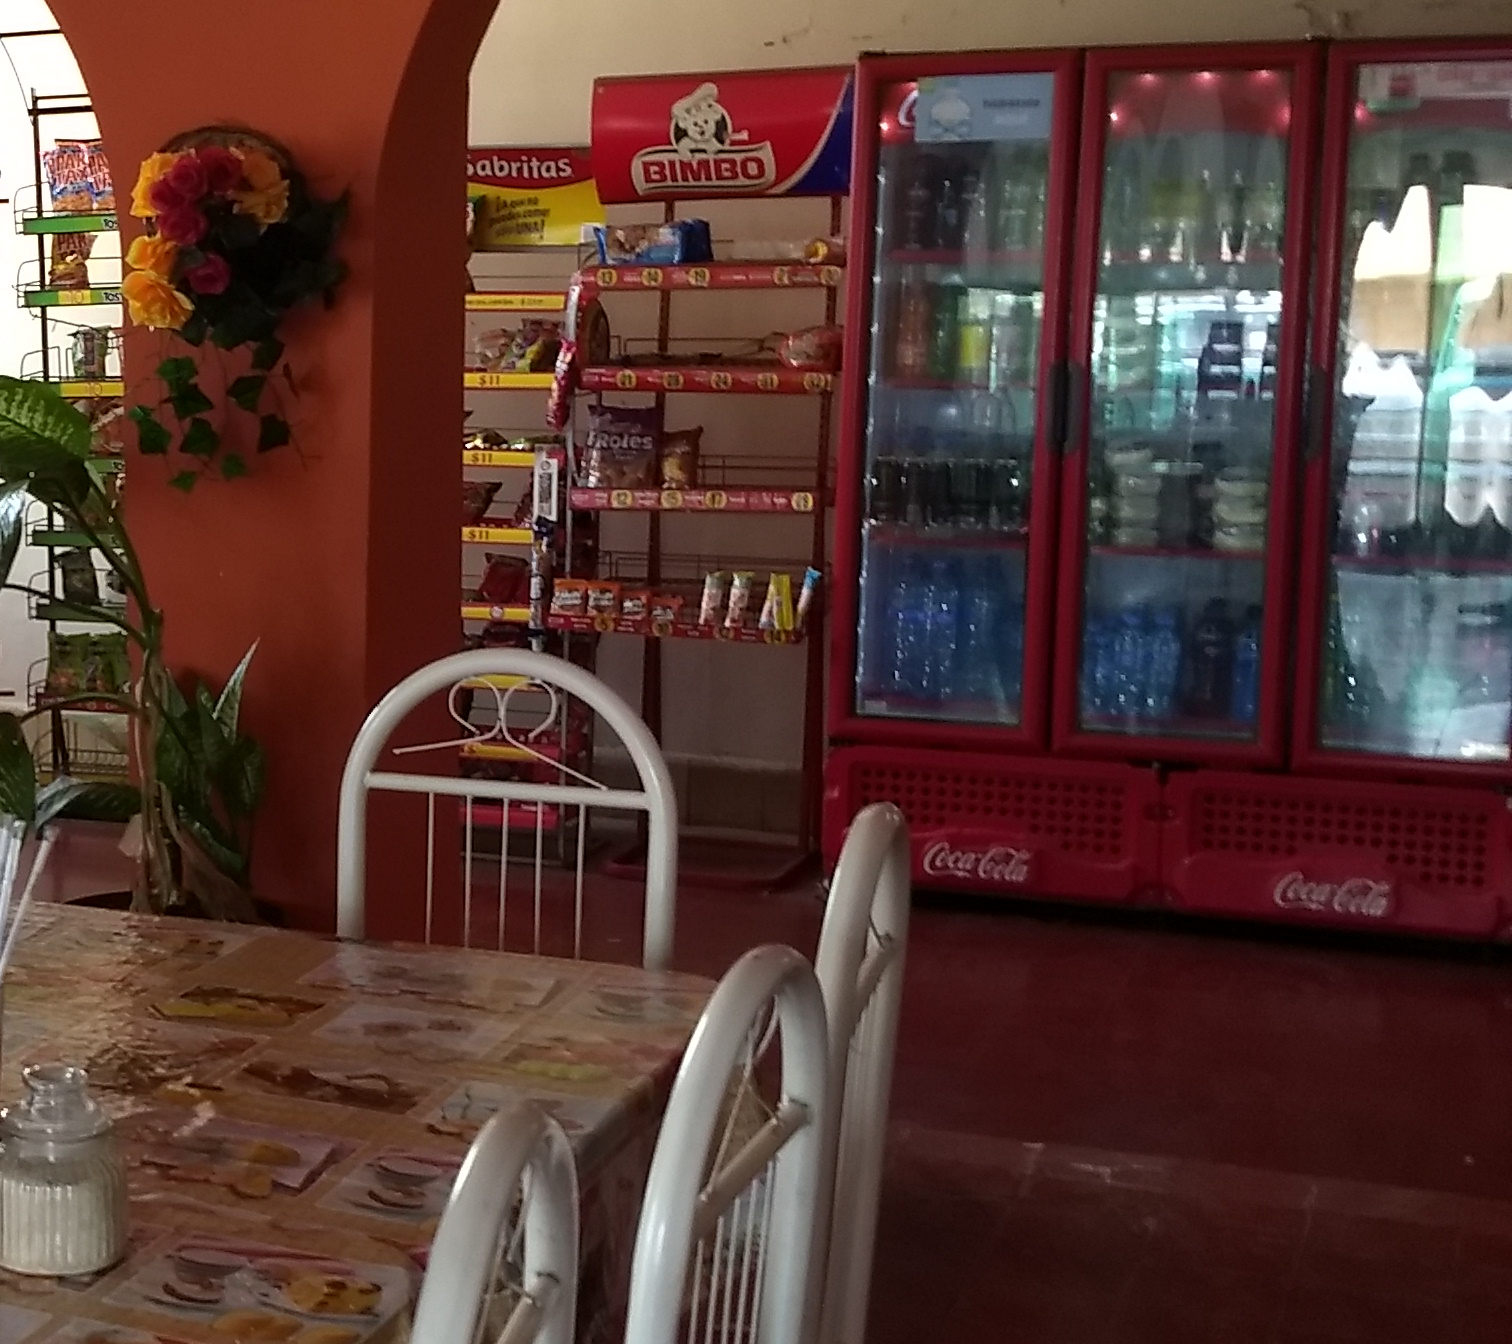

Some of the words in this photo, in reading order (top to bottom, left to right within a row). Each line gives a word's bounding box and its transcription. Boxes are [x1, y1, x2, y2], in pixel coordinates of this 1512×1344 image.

[640, 155, 766, 184] BIMBO
[921, 840, 1034, 883] Coca-Cola
[1272, 869, 1391, 918] Coca-Cola
